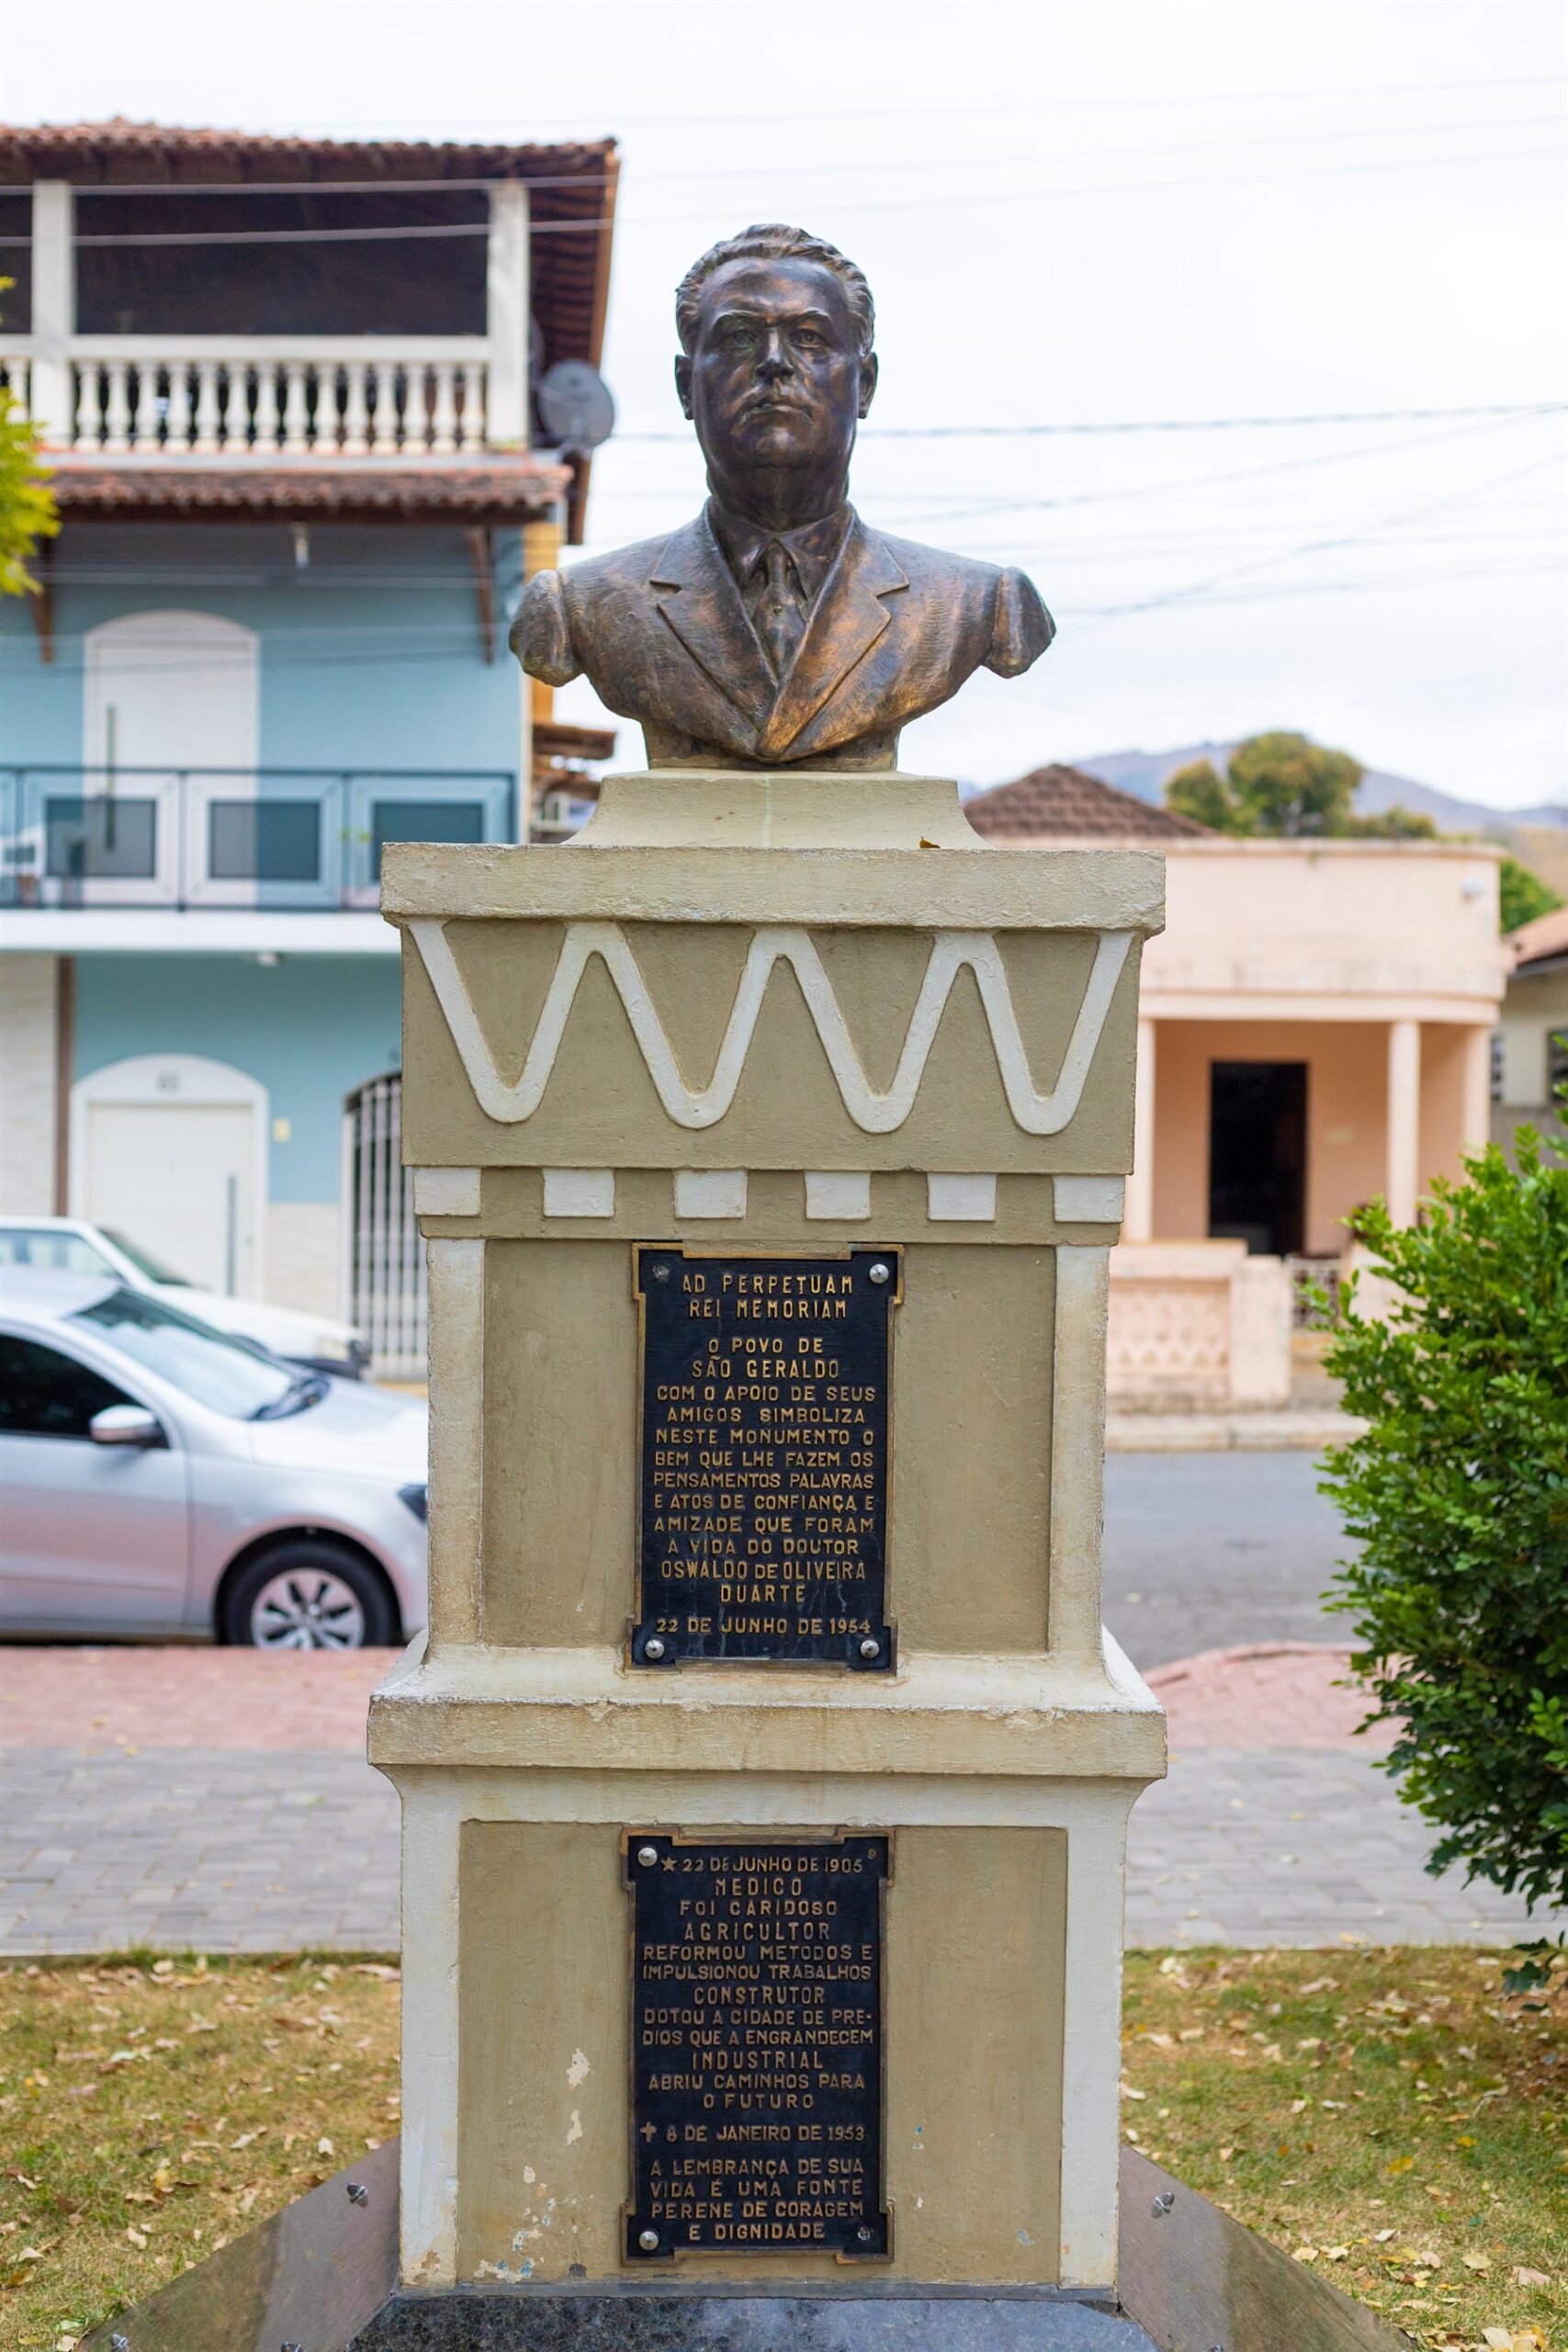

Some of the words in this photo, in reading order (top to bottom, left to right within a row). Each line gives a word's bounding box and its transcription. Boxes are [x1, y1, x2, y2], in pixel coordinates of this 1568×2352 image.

[682, 1274, 705, 1294] AD
[723, 1274, 852, 1295] PERPETUAM
[690, 1299, 720, 1317] REI
[737, 1300, 846, 1318] MEMORIAM
[708, 1339, 718, 1353] O
[731, 1338, 783, 1353] POVO
[798, 1338, 823, 1353] DE
[692, 1355, 731, 1378] SÃO
[747, 1360, 840, 1378] GERALDO
[657, 1385, 694, 1401] COM
[705, 1386, 714, 1400] O
[725, 1385, 779, 1401] APOIO
[791, 1385, 816, 1402] DE
[827, 1385, 875, 1402] SEUS
[667, 1408, 741, 1422] AMIGOS
[760, 1408, 865, 1423] SIMBOLIZA
[656, 1429, 717, 1444] NESTE
[730, 1430, 850, 1445] MONUMENTO
[863, 1430, 873, 1445] O
[655, 1452, 689, 1466] BEM
[700, 1452, 732, 1469] QUE
[742, 1452, 773, 1466] LHE
[786, 1452, 840, 1467] FAZEM
[851, 1452, 873, 1467] OS
[653, 1473, 780, 1487] PENSAMENTOS
[790, 1474, 874, 1488] PALAVRAS
[654, 1494, 662, 1509] E
[670, 1495, 713, 1510] ATOS
[720, 1495, 743, 1510] DE
[754, 1495, 857, 1513] CONFIANÇA
[865, 1496, 874, 1510] E
[654, 1517, 742, 1532] AMIZADE
[755, 1518, 792, 1534] QUE
[805, 1518, 873, 1533] FORAM
[668, 1539, 679, 1554] A
[690, 1539, 735, 1555] VIDA
[748, 1540, 772, 1555] DO
[783, 1540, 859, 1555] DOUTOR
[661, 1560, 748, 1579] OSWALDO
[755, 1565, 777, 1579] DE
[783, 1562, 865, 1580] OLIVEIRA
[720, 1584, 806, 1603] DUARTE
[656, 1619, 678, 1633] 22
[688, 1617, 711, 1633] DE
[721, 1618, 787, 1634] JUNHO
[797, 1618, 822, 1634] DE
[829, 1619, 871, 1634] 1954
[682, 1859, 704, 1872] 22
[710, 1858, 729, 1872] DE
[733, 1858, 791, 1872] JUNHO
[797, 1858, 818, 1872] DE
[825, 1859, 863, 1872] 1905
[716, 1878, 801, 1896] MEDICO
[680, 1901, 715, 1916] FOI
[729, 1901, 837, 1916] CARIDOSO
[684, 1922, 829, 1940] AGRICULTOR
[643, 1946, 745, 1961] REFORMOU
[761, 1945, 852, 1961] METODOS
[862, 1945, 872, 1961] E
[643, 1964, 760, 1980] IMPULSIONOU
[769, 1965, 871, 1980] TRABALHOS
[694, 1987, 824, 2005] CONSTRUTOR
[644, 2008, 704, 2025] DOTOU
[713, 2010, 724, 2024] A
[730, 2010, 795, 2025] CIDADE
[803, 2010, 824, 2025] DE
[832, 2010, 872, 2025] PRE-
[643, 2030, 682, 2045] DIOS
[690, 2030, 721, 2046] QUE
[729, 2030, 739, 2044] A
[746, 2030, 873, 2045] ENGRANDECEM
[693, 2051, 823, 2069] INDUSTRIAL
[649, 2075, 703, 2089] ABRIU
[714, 2074, 808, 2089] CAMINHOS
[818, 2075, 864, 2088] PARA
[704, 2094, 714, 2109] O
[725, 2095, 814, 2109] FUTURO
[684, 2125, 707, 2142] DE
[716, 2125, 790, 2142] JANEIRO
[798, 2125, 821, 2141] DE
[828, 2126, 864, 2140] 1953
[650, 2160, 661, 2176] A
[673, 2159, 789, 2179] LEMBRANÇA
[798, 2158, 821, 2175] DE
[829, 2158, 863, 2174] SUA
[650, 2182, 694, 2198] VIDA
[711, 2178, 722, 2197] É
[739, 2181, 781, 2197] UMA
[797, 2179, 863, 2196] FONTE
[651, 2201, 733, 2219] PERENE
[742, 2201, 768, 2218] DE
[775, 2201, 863, 2218] CORAGEM
[690, 2224, 701, 2240] E
[716, 2222, 825, 2239] DIGNIDADE
